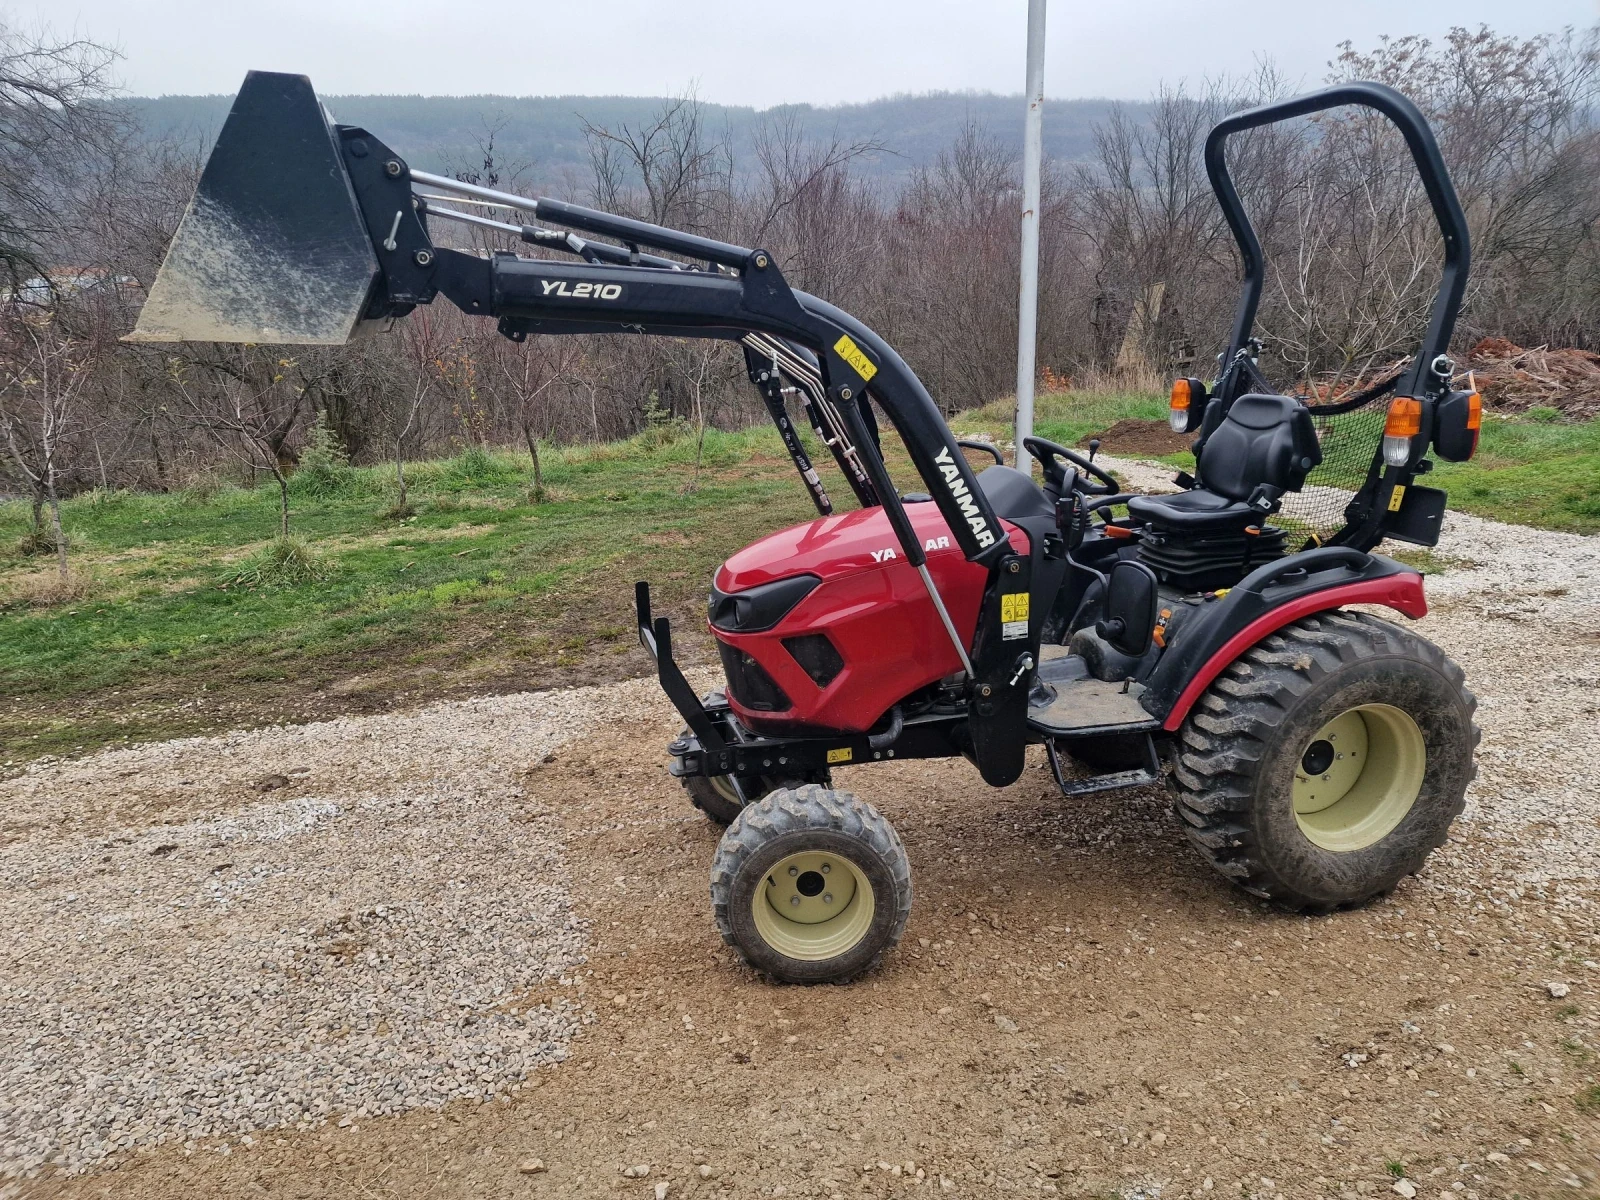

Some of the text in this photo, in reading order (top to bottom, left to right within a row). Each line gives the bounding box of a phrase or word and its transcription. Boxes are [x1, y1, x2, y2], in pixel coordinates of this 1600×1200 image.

[541, 280, 622, 300] YL210
[934, 446, 995, 549] YANMAR
[870, 536, 950, 563] YAAR
